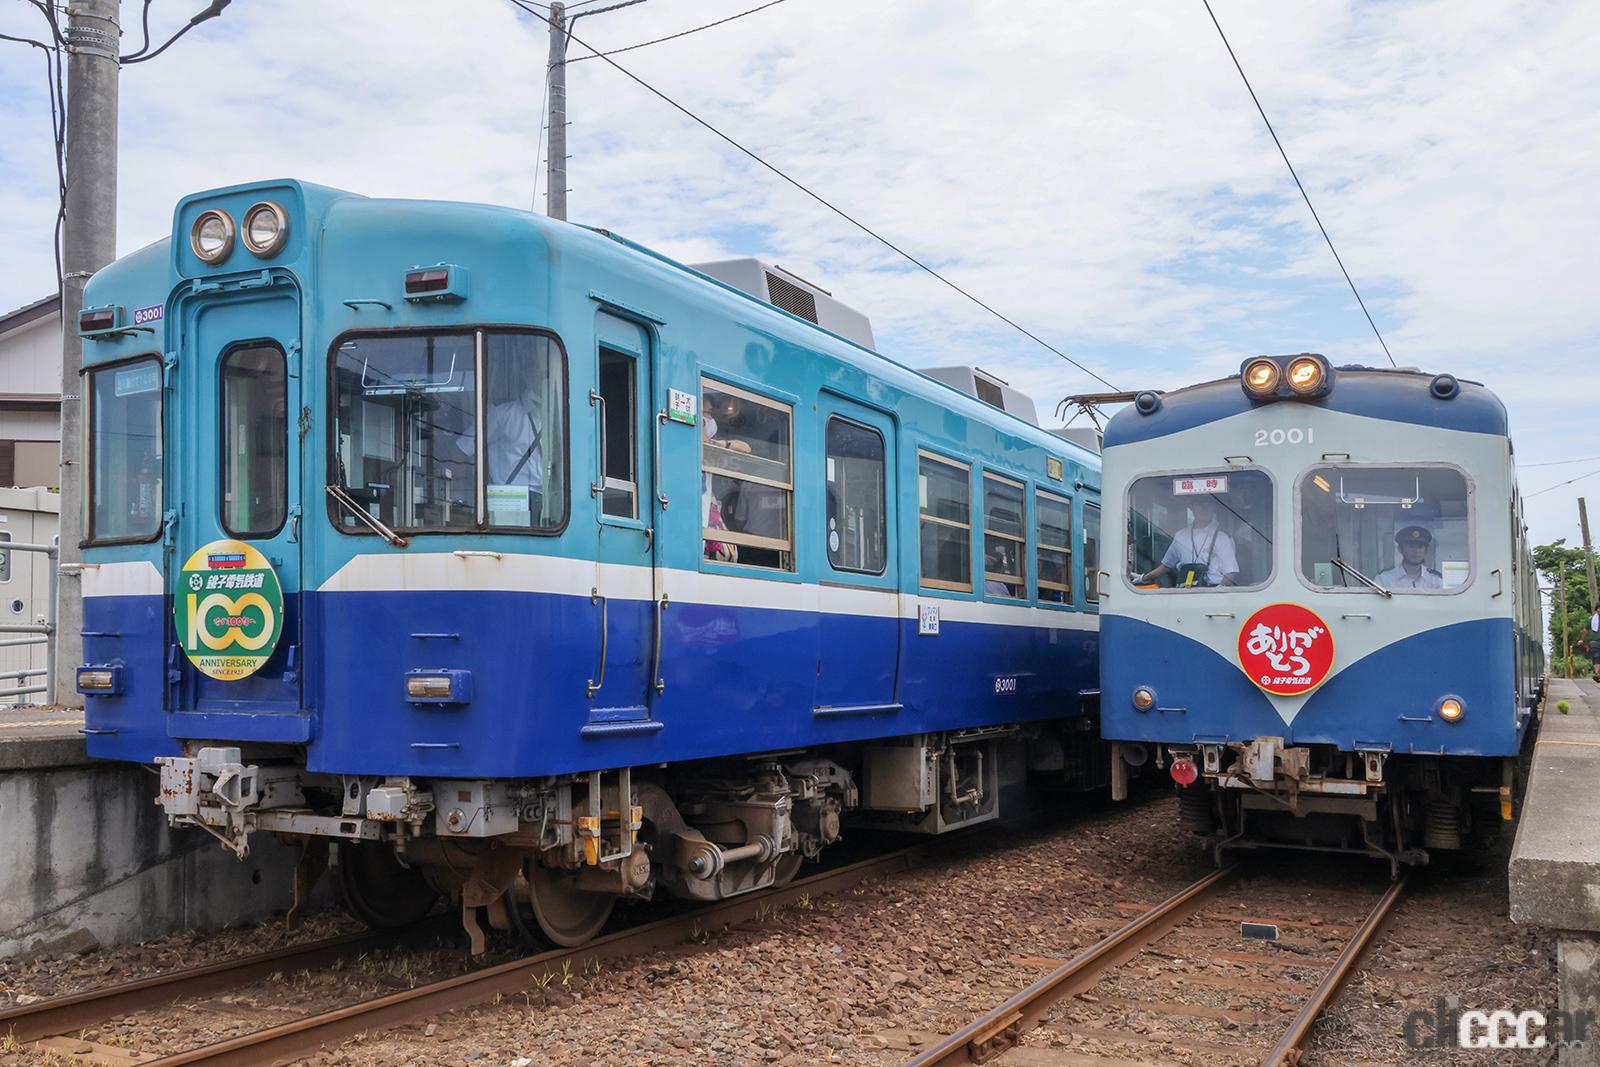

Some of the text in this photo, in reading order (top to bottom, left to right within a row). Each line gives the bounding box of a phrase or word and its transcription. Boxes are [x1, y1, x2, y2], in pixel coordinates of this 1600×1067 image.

[142, 306, 162, 321] 3001
[1255, 427, 1313, 446] 2001
[205, 573, 265, 589] 銚子電気鉄道
[187, 592, 275, 650] 100
[1246, 623, 1325, 655] ありが
[200, 658, 257, 668] ANNIVERSARY
[1265, 647, 1311, 676] とう
[1001, 679, 1017, 691] 3001
